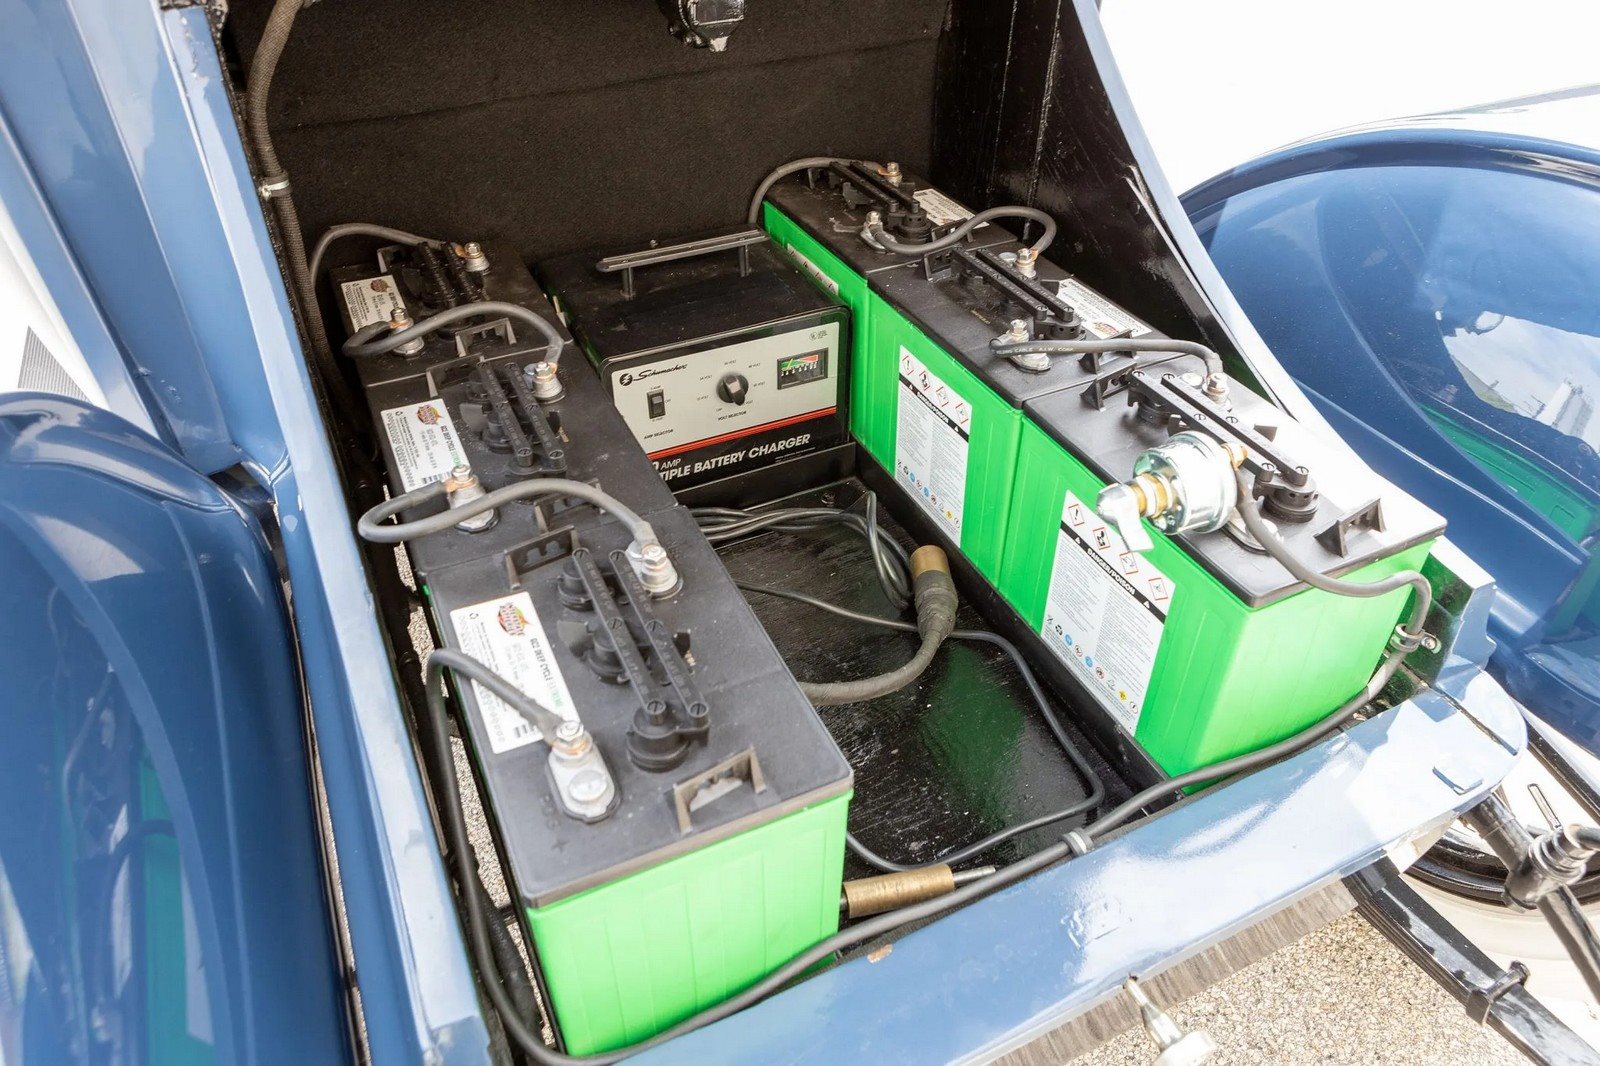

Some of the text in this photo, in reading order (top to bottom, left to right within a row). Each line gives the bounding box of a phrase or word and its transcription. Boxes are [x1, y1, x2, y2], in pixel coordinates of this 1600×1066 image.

[631, 364, 687, 381] Schumacher
[659, 465, 691, 482] TIPLE
[693, 451, 747, 473] BATTERY
[748, 434, 811, 460] CHARGER
[660, 458, 681, 470] AMP
